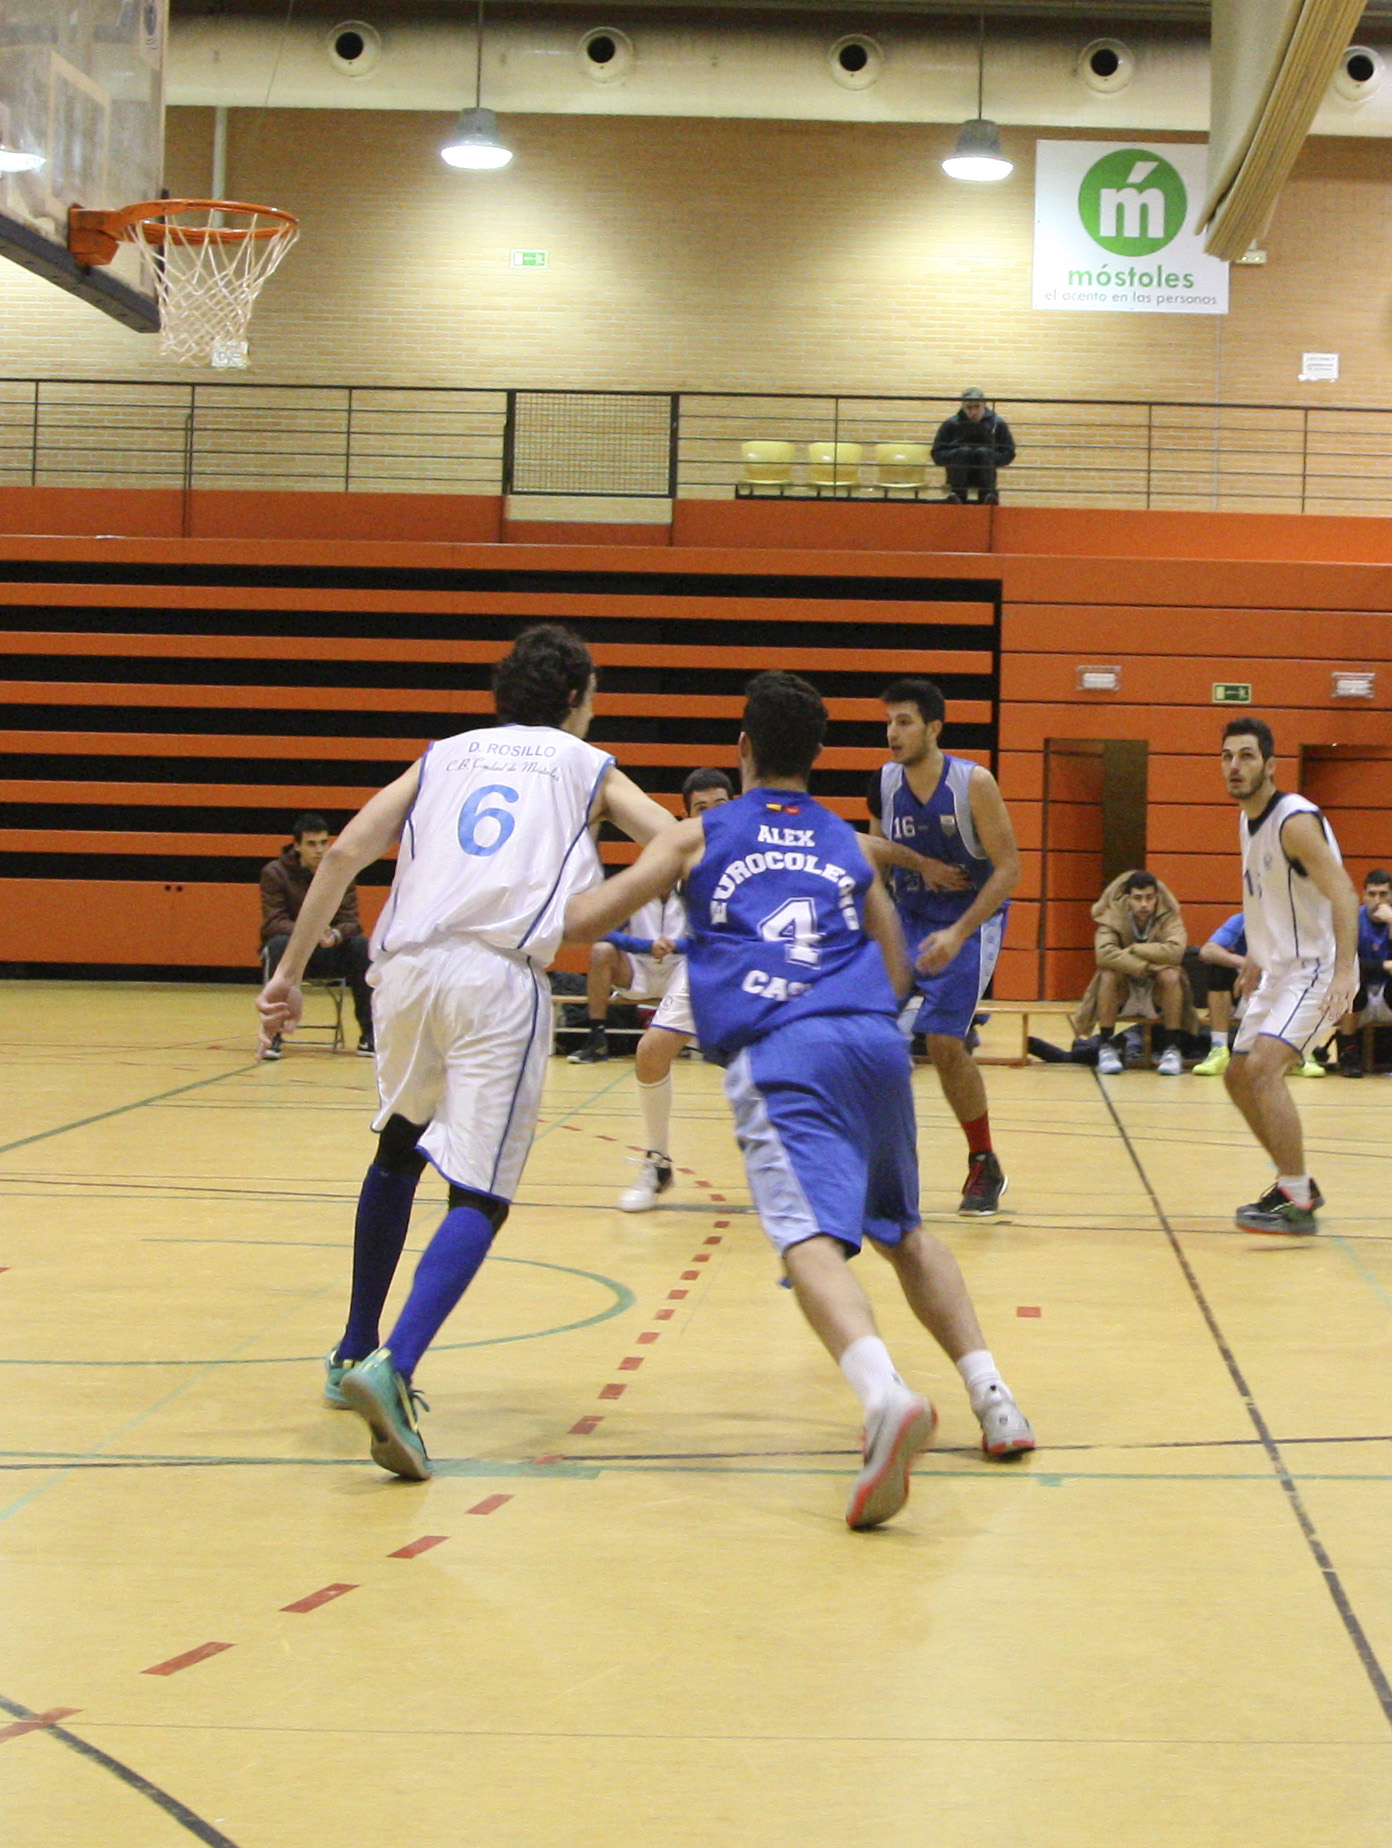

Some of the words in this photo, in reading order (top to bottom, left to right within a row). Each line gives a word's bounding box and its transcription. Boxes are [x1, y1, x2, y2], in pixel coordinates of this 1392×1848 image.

[1067, 264, 1195, 289] móstoles
[1045, 290, 1057, 301] el
[1112, 293, 1128, 303] en
[1132, 291, 1151, 304] las
[1156, 294, 1217, 306] personas
[468, 741, 481, 754] D.
[487, 743, 557, 758] ROSILLO
[457, 784, 520, 857] 6
[894, 815, 916, 839] 16
[757, 824, 816, 847] ALEX
[757, 897, 827, 970] 4
